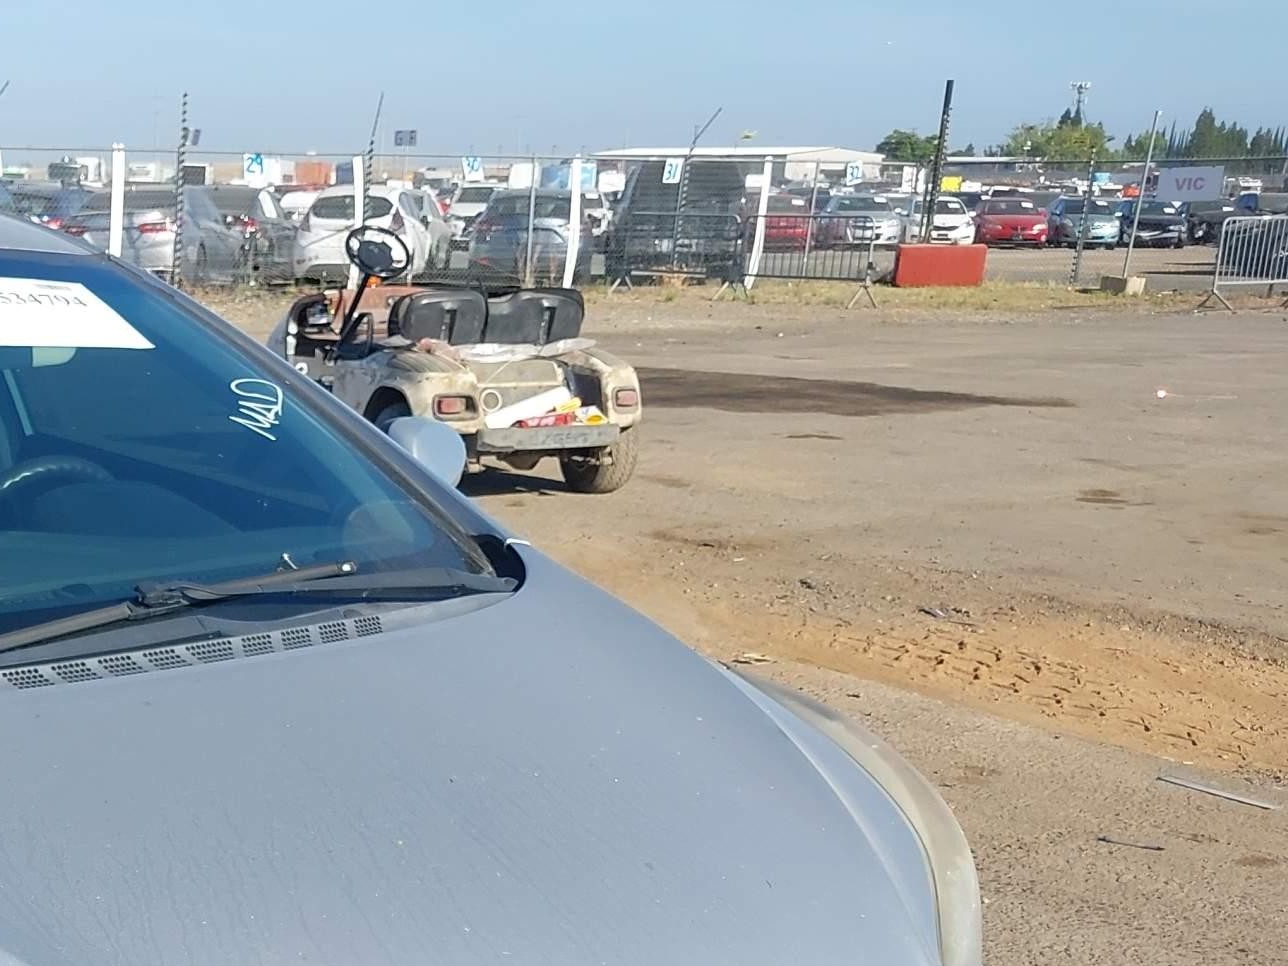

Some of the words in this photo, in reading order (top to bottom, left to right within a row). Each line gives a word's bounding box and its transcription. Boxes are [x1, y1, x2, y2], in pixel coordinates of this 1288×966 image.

[246, 153, 263, 174] 29
[1175, 177, 1205, 191] VIC
[229, 378, 283, 441] MAD
